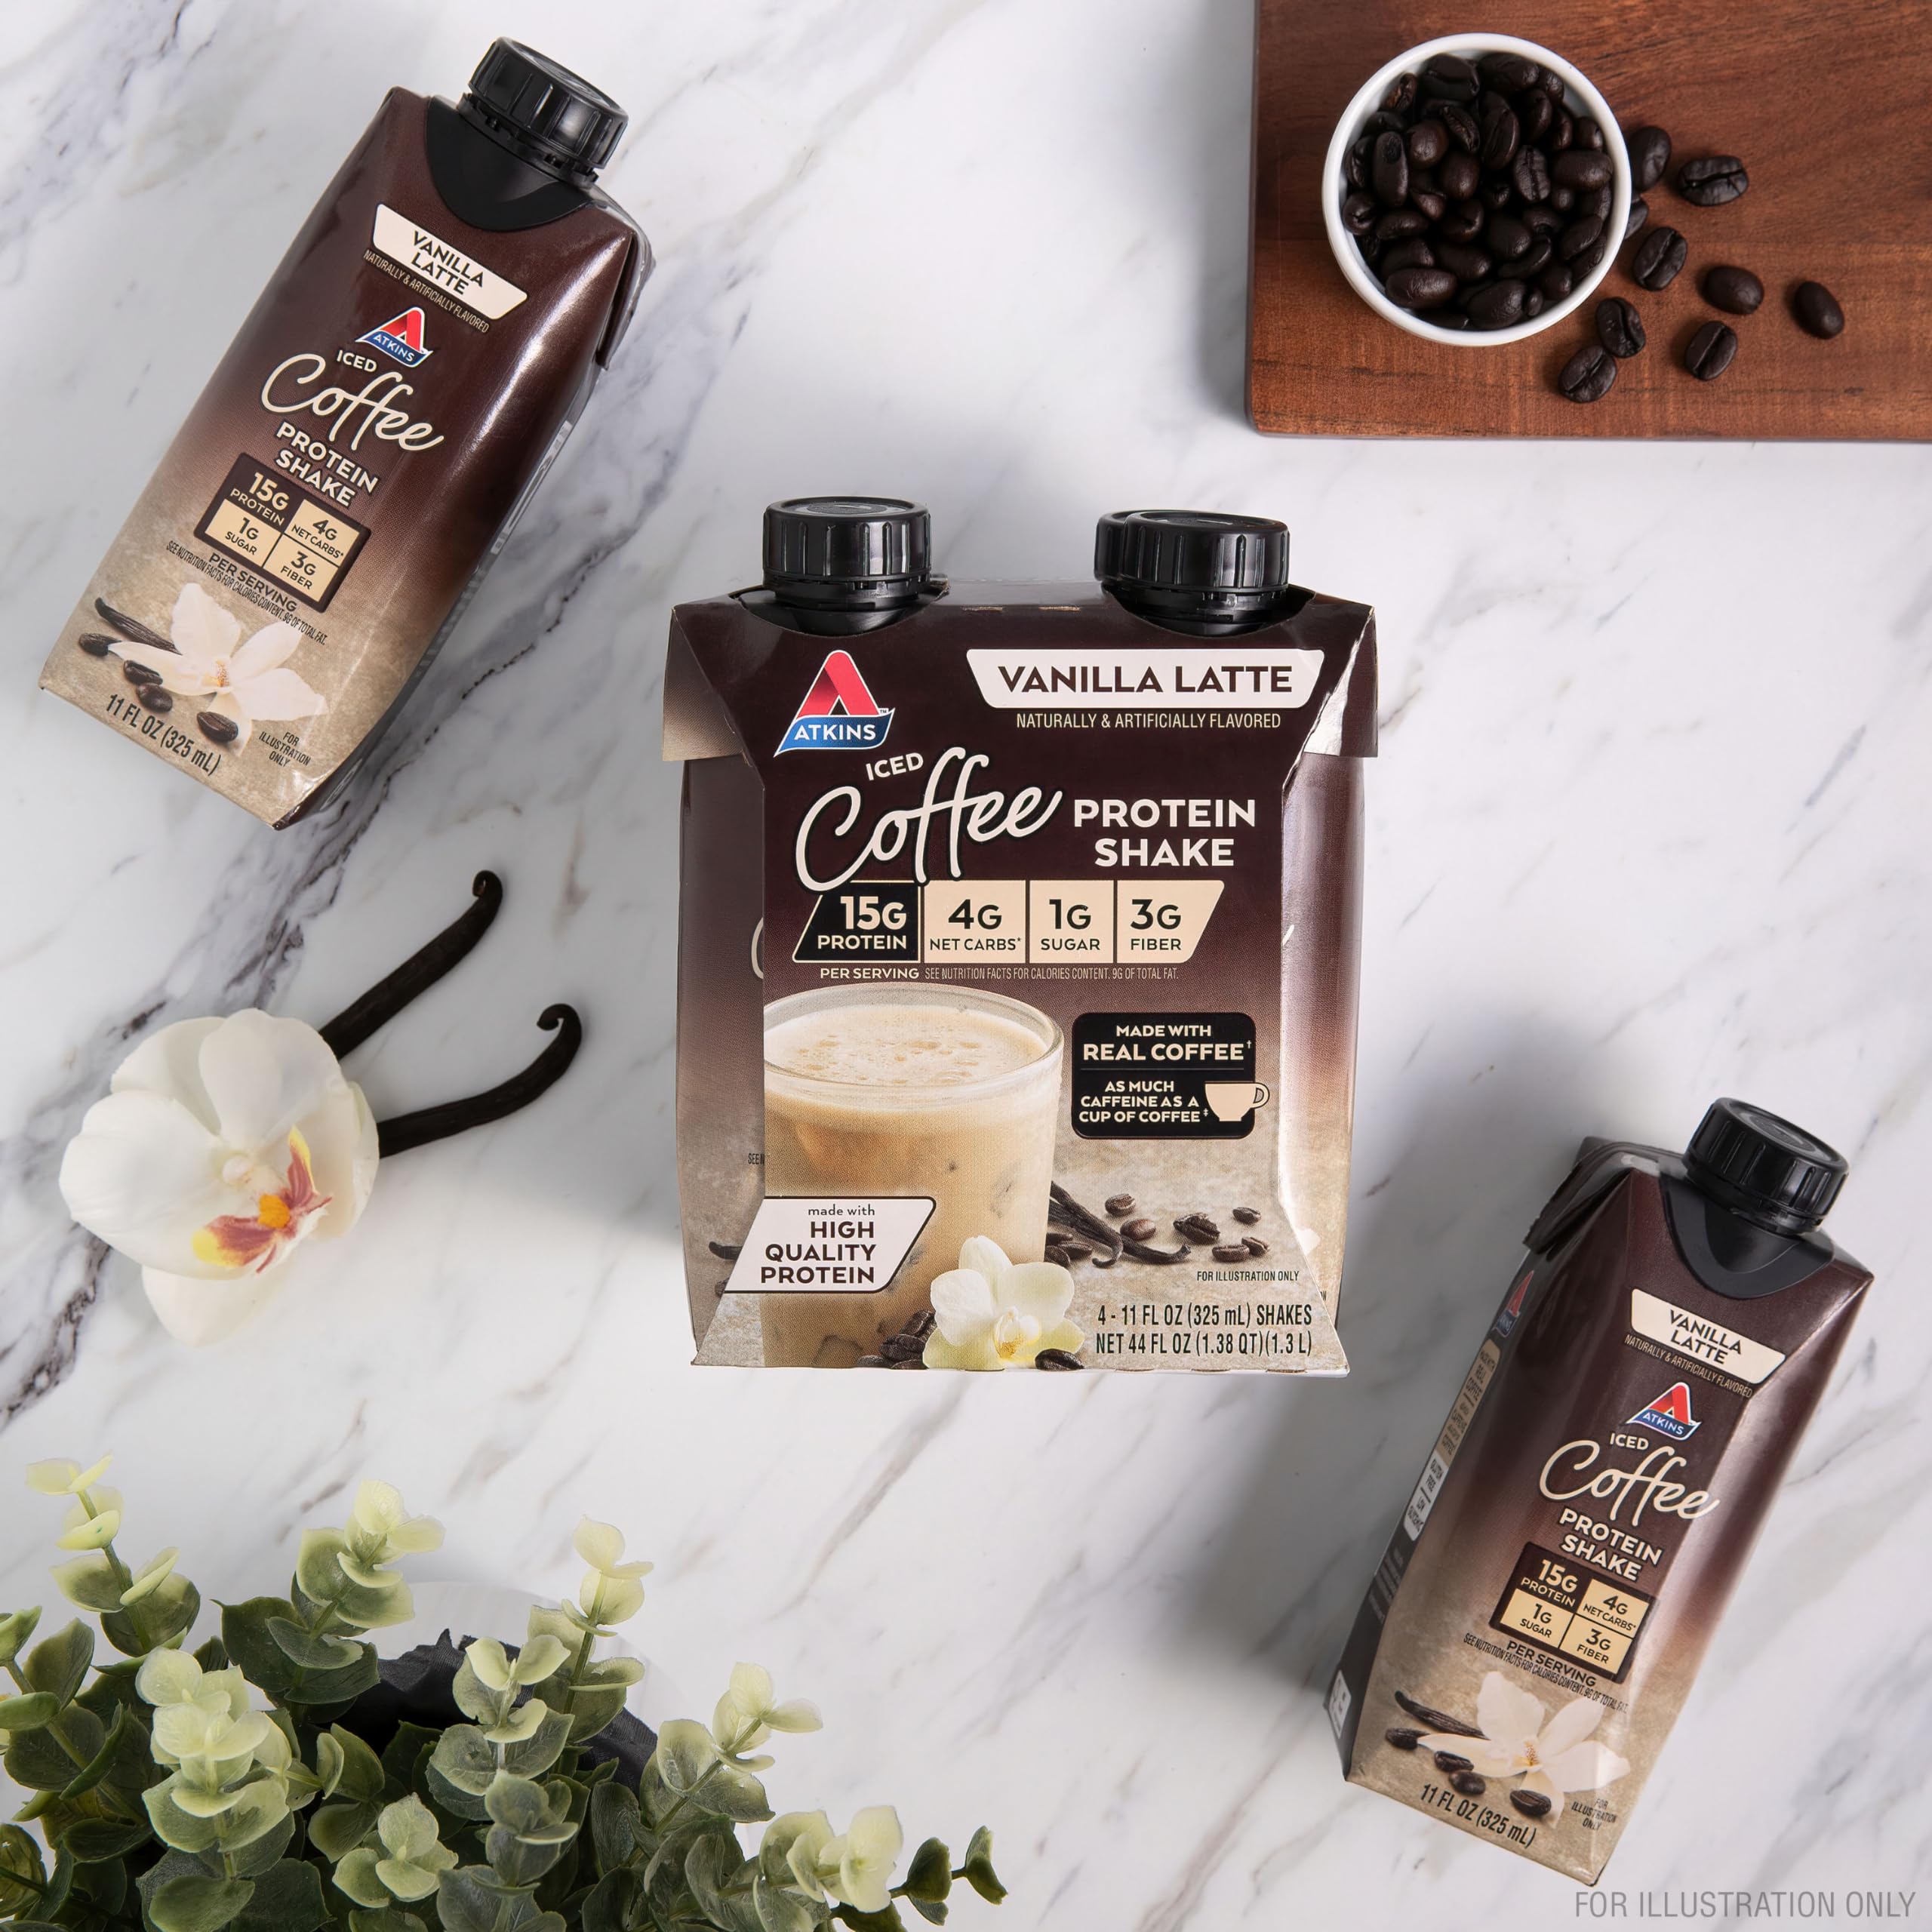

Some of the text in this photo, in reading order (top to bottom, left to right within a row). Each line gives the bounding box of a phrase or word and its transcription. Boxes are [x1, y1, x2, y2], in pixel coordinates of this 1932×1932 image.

[413, 230, 484, 288] VANILLA
[411, 252, 469, 295] LATTE
[363, 249, 490, 334] NATURALLY & ARTIFICIALLY FLAVORED
[373, 334, 415, 362] ATKINS
[337, 349, 377, 373] ICED
[262, 353, 445, 451] Coffee
[276, 421, 378, 494] PROTEIN
[275, 450, 355, 506] SHAKE
[248, 472, 290, 511] 15G
[230, 488, 285, 526] PROTEIN
[238, 517, 259, 540] 1G
[291, 525, 310, 540] NET
[312, 519, 337, 541] 4G
[225, 531, 257, 555] SUGAR
[291, 551, 316, 576] 3G
[166, 540, 179, 554] SEE
[176, 546, 208, 571] NUTRITION
[205, 564, 223, 582] FACTS
[221, 574, 235, 589] FOR
[232, 581, 260, 604] CALORIES
[257, 597, 285, 620] CONTENT.
[283, 612, 293, 624] 9G
[291, 617, 300, 628] OF
[298, 620, 316, 638] TOTAL
[208, 552, 298, 612] PER SERVING
[280, 566, 313, 590] FIBER
[998, 666, 1293, 693] VANILLA LATTE
[794, 724, 876, 741] ATKINS
[1017, 713, 1281, 729] NATURALLY & ARTIFICIALLY FLAVORED
[106, 694, 222, 777] 11 FL OZ (325 mL)
[283, 731, 300, 746] FOR
[259, 731, 311, 766] ILLUSTRATION
[269, 750, 291, 768] ONLY
[865, 752, 924, 781] ICED
[795, 746, 1063, 892] Coffee
[1074, 799, 1256, 828] PROTEIN
[1094, 838, 1235, 867] SHAKE
[840, 895, 906, 931] 15G
[948, 899, 1002, 930] 4G
[1049, 899, 1092, 930] 1G
[1130, 899, 1182, 930] 3G
[817, 935, 906, 950] PROTEIN
[929, 938, 961, 951] NET
[1041, 938, 1100, 951] SUGAR
[1131, 938, 1182, 951] FIBER
[820, 968, 919, 980] PER SERVING
[925, 968, 1179, 980] SEE NUTRITION FACTS FOR CALORIES CONTENT. 9G OF TOTAL FAT.
[1116, 1025, 1212, 1037] MADE WITH
[1083, 1043, 1146, 1061] REAL
[1105, 1081, 1174, 1092] AS MUCH
[1080, 1096, 1199, 1107] CAFFEINE AS A
[1079, 1111, 1111, 1122] CUP
[1114, 1111, 1136, 1122] OF
[748, 1153, 759, 1164] SEE
[808, 1204, 875, 1216] made with
[810, 1221, 874, 1238] HIGH
[765, 1244, 877, 1262] QUALITY
[761, 1266, 875, 1284] PROTEIN
[1197, 1271, 1300, 1281] FOR ILLUSTRATION ONLY
[1097, 1305, 1106, 1323] 4
[1121, 1305, 1137, 1325] 11
[1143, 1305, 1159, 1325] FL
[1164, 1304, 1183, 1326] OZ
[1188, 1303, 1220, 1329] (325
[1224, 1303, 1251, 1329] mL)
[1257, 1303, 1312, 1326] SHAKES
[1097, 1334, 1124, 1354] NET
[1128, 1334, 1146, 1354] 44
[1151, 1334, 1168, 1354] FL
[1172, 1333, 1191, 1354] OZ
[1195, 1331, 1233, 1357] (1.38
[1299, 1331, 1312, 1357] L)
[1670, 1309, 1741, 1355] VANILLA
[1670, 1330, 1728, 1364] LATTE
[1624, 1334, 1753, 1398] NATURALLY & ARTIFICIALLY FLAVORED
[1642, 1411, 1685, 1435] ATKINS
[1610, 1432, 1649, 1451] ICED
[1540, 1440, 1720, 1527] Coffee
[1559, 1508, 1663, 1565] PROTEIN
[1561, 1534, 1641, 1581] SHAKE
[1539, 1558, 1578, 1593] 15G
[1521, 1577, 1576, 1607] PROTEIN
[1532, 1603, 1552, 1624] 1G
[1583, 1604, 1603, 1618] NET
[1603, 1595, 1628, 1615] 4G
[1519, 1618, 1552, 1638] SUGAR
[1586, 1629, 1611, 1651] 3G
[1506, 1641, 1597, 1687] PER SERVING
[1577, 1644, 1610, 1664] FIBER
[1464, 1632, 1477, 1646] SEE
[1474, 1638, 1506, 1660] NUTRITION
[1503, 1651, 1522, 1667] FACTS
[1520, 1659, 1534, 1672] FOR
[1531, 1664, 1560, 1684] CALORIES
[1592, 1690, 1601, 1702] OF
[1600, 1694, 1617, 1709] TOTAL
[1420, 1784, 1537, 1848] 11 FL OZ (325 mL)
